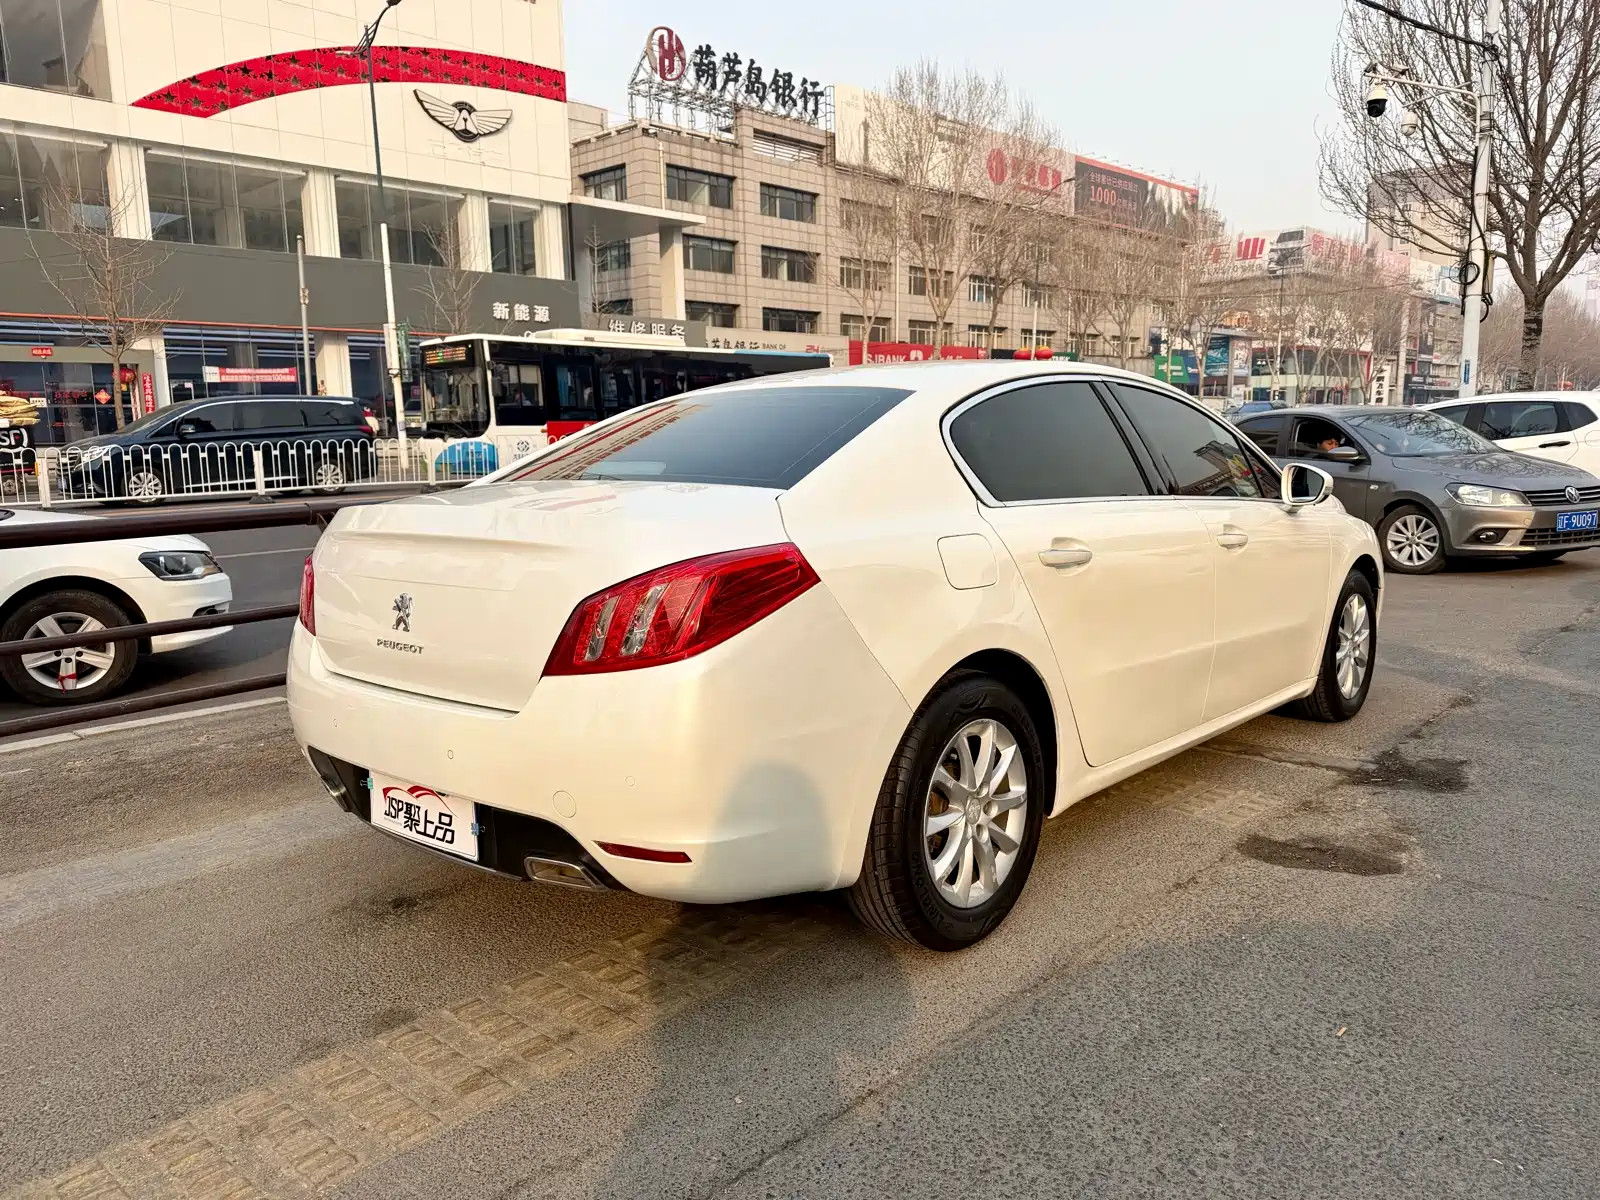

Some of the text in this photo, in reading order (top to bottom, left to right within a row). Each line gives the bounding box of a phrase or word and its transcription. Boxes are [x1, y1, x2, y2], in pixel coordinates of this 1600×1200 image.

[693, 43, 825, 118] 葫芦岛银行
[492, 301, 550, 323] 新能源
[608, 319, 685, 339] 维修服务
[376, 638, 424, 655] PEUGEOT
